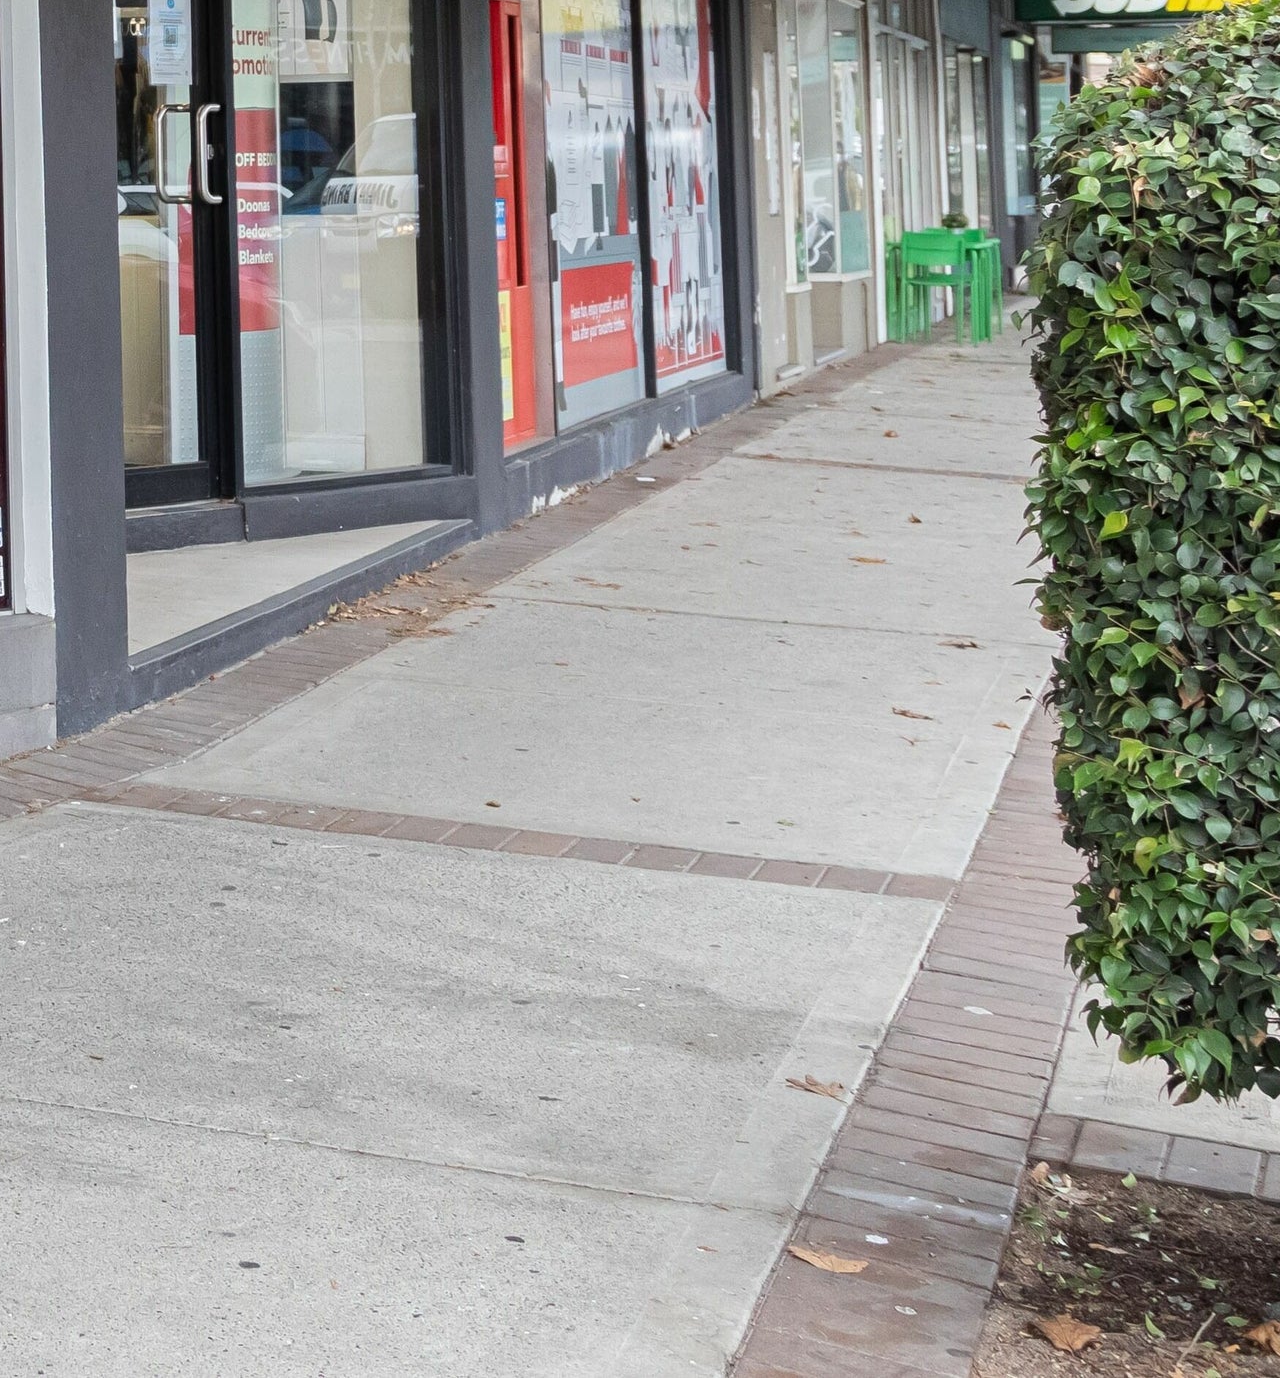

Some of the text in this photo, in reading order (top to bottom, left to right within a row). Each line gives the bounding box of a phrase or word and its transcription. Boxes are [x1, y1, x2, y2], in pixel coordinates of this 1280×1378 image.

[235, 152, 256, 167] OFF
[237, 198, 271, 213] Doonas
[239, 249, 274, 265] Blankets
